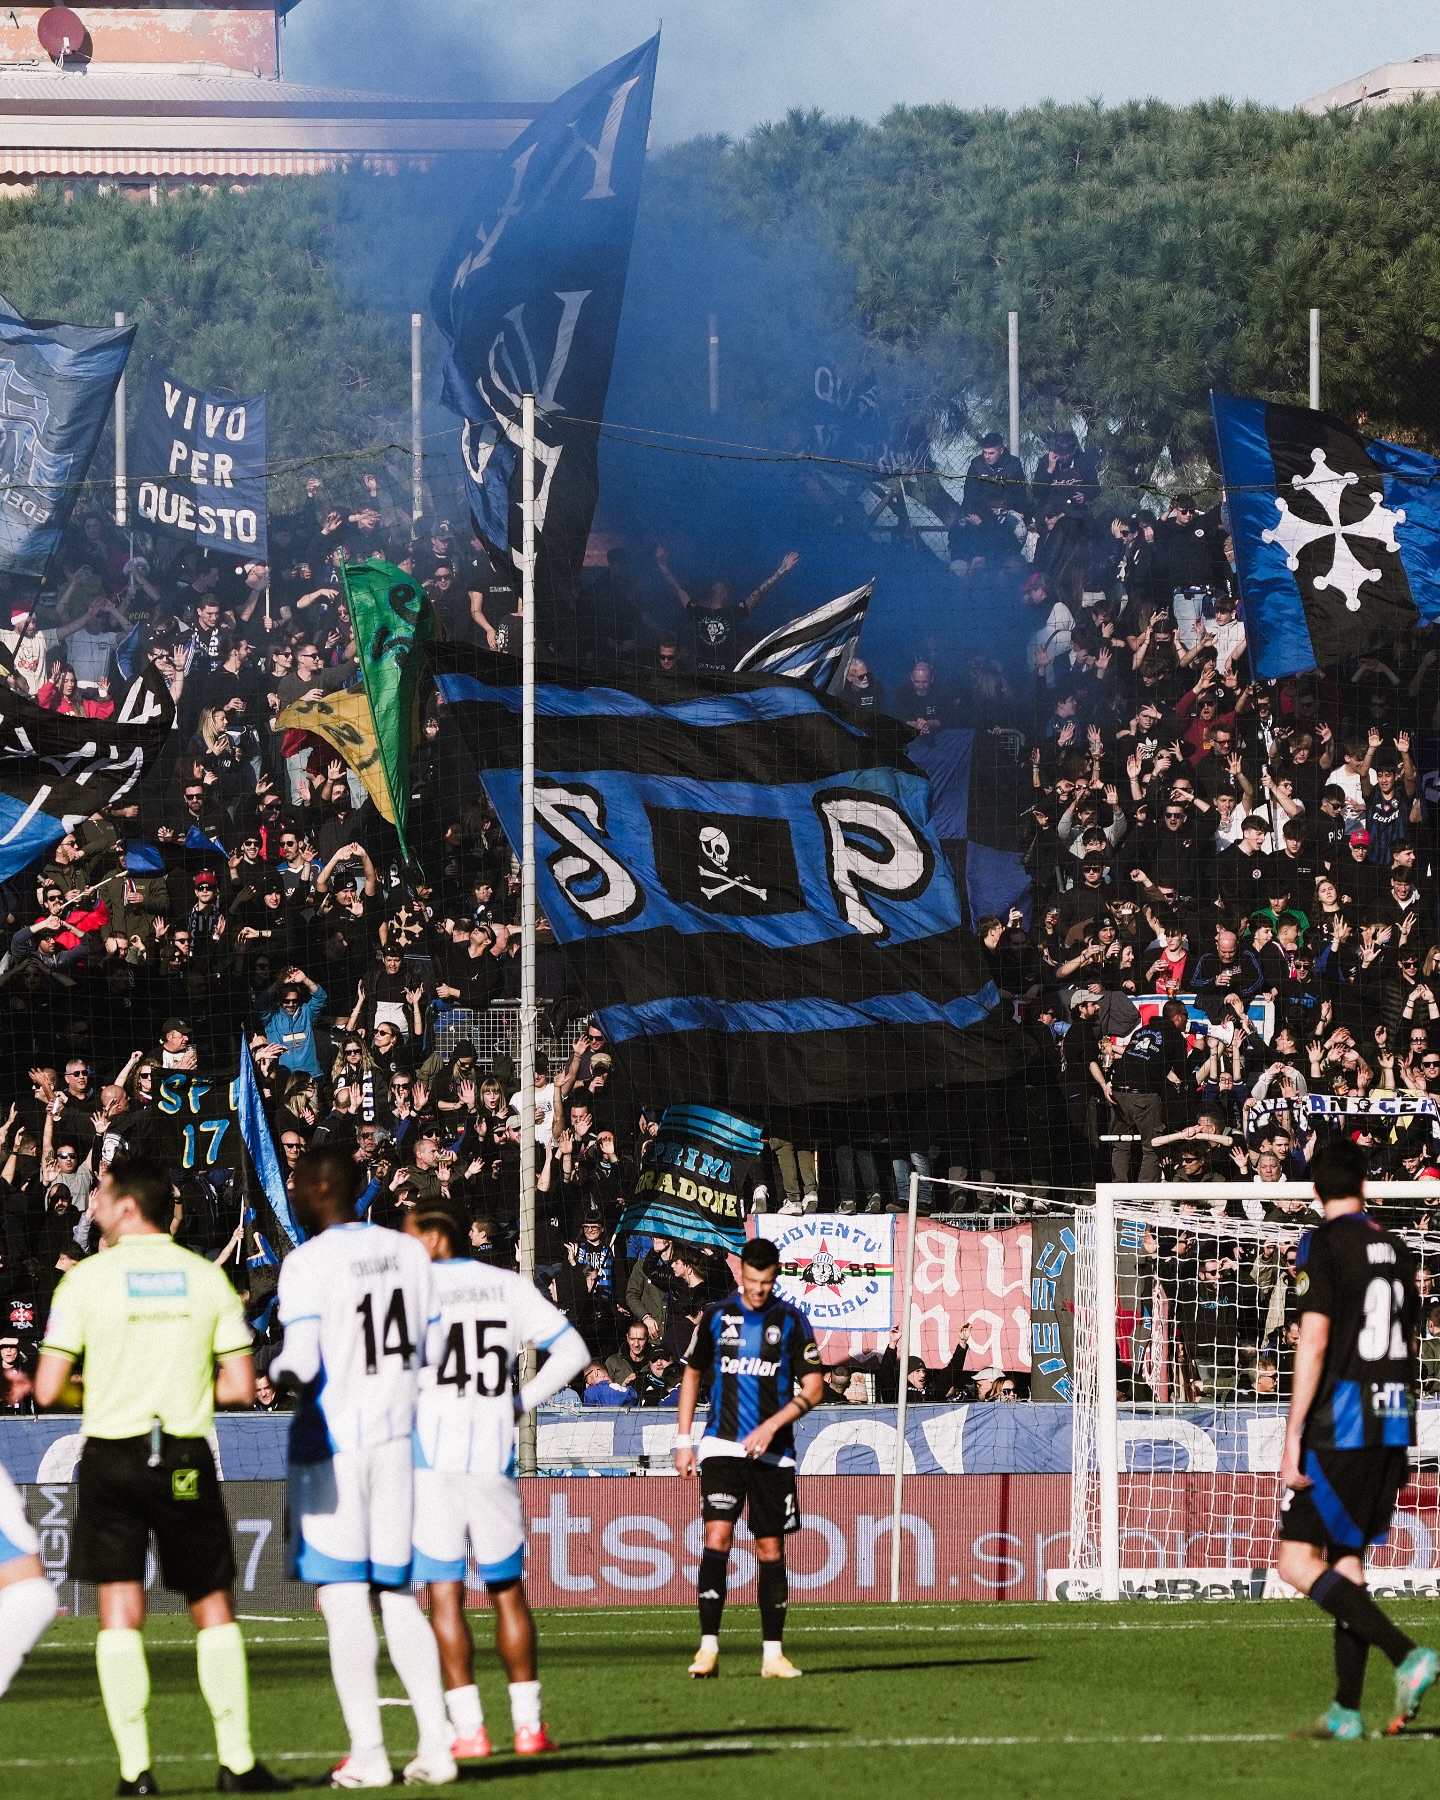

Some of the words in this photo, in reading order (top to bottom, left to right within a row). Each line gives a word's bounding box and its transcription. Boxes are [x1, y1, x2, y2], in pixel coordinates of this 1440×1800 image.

[164, 381, 246, 441] VIVO
[169, 439, 234, 488] PER
[138, 482, 257, 543] QUESTO
[526, 782, 642, 922] S
[818, 790, 931, 938] P
[182, 1119, 230, 1169] 17
[650, 1141, 732, 1183] PRIMO
[356, 1288, 416, 1375] 14
[437, 1320, 508, 1398] 45
[720, 1355, 783, 1377] Cetilar
[1056, 1578, 1252, 1600] GldBet
